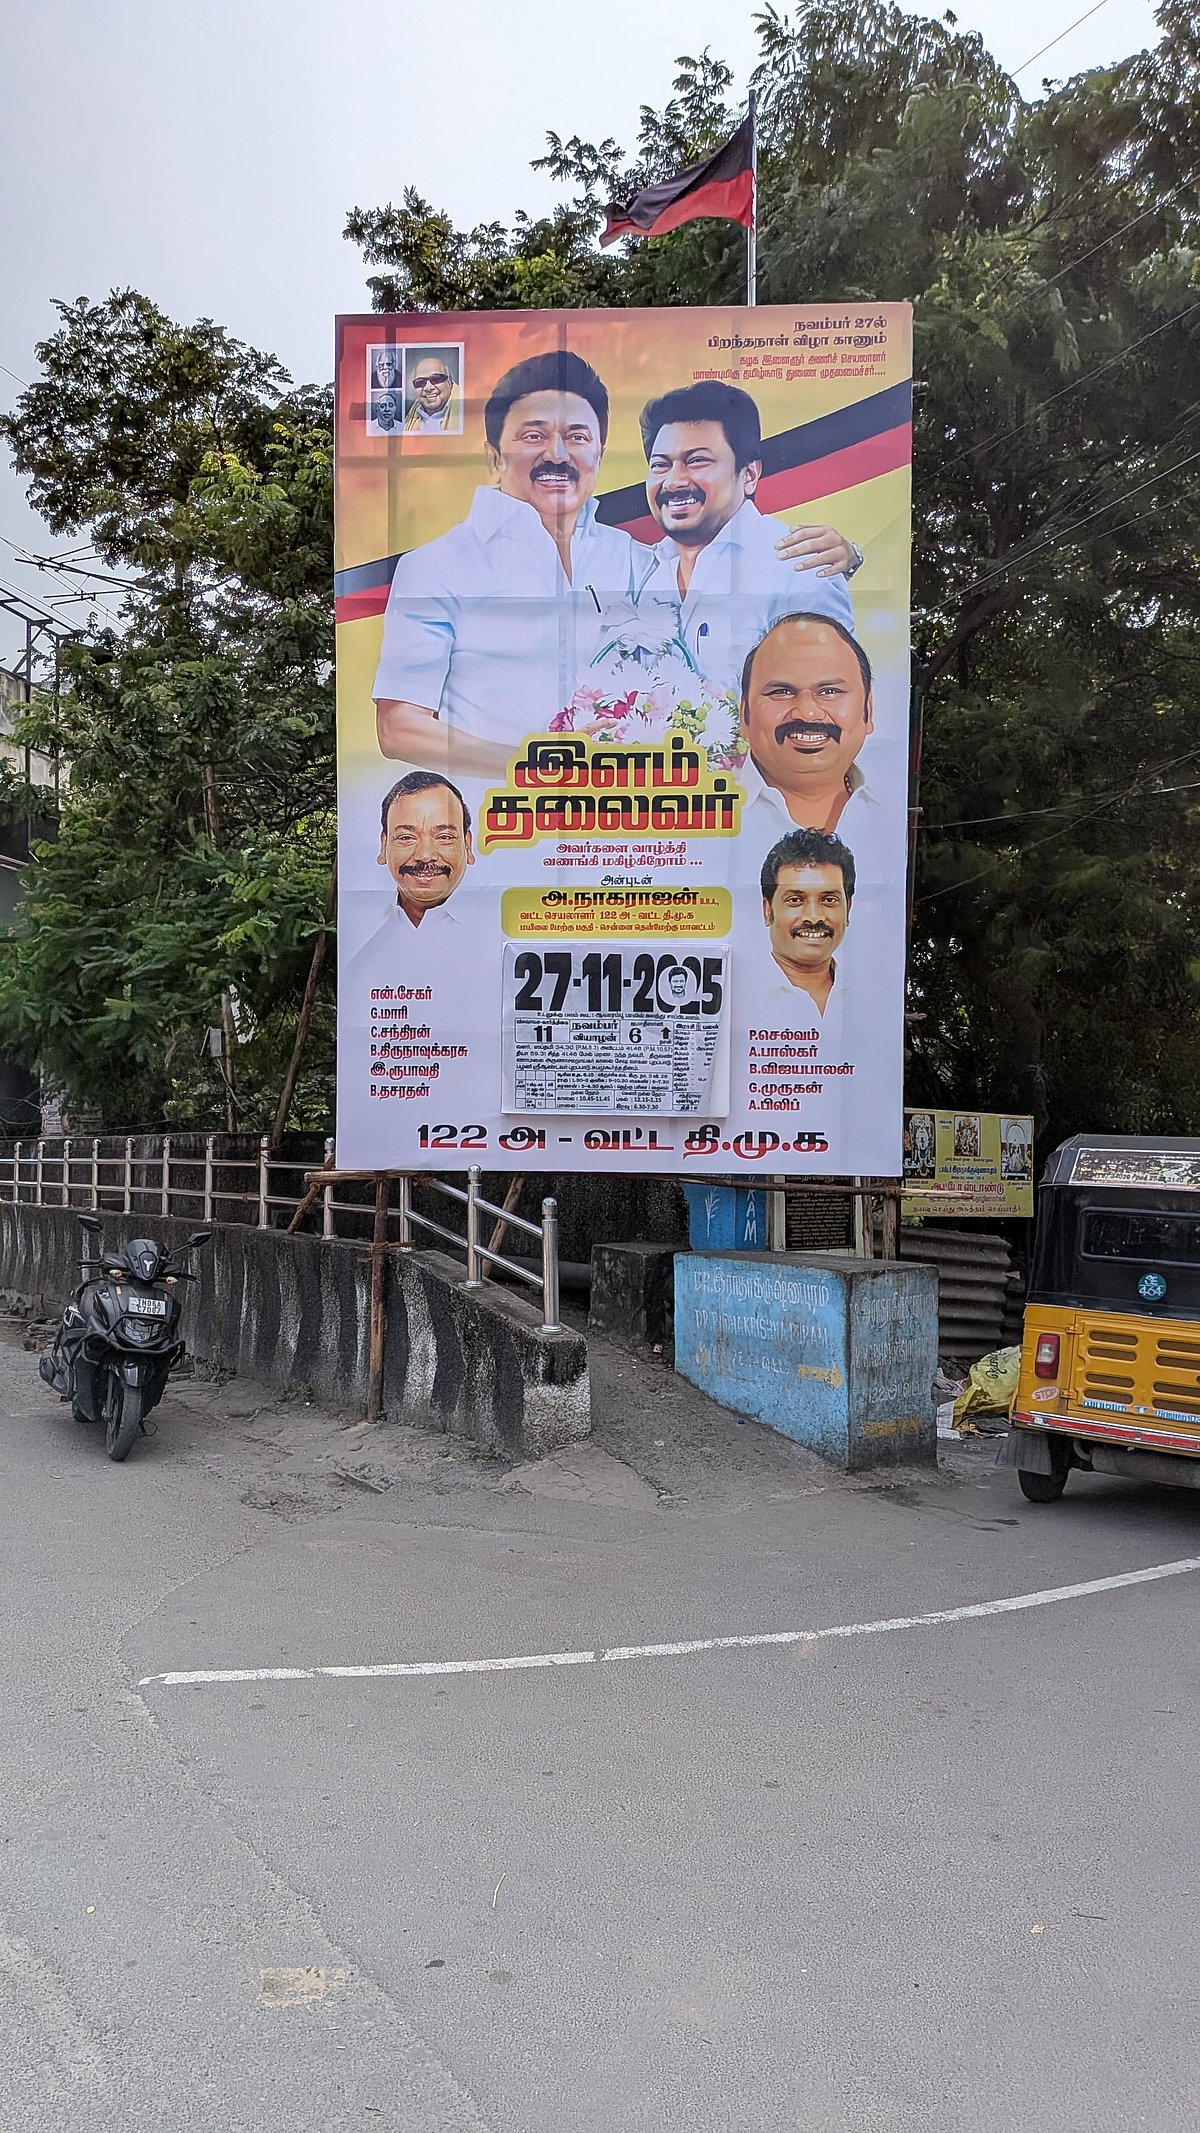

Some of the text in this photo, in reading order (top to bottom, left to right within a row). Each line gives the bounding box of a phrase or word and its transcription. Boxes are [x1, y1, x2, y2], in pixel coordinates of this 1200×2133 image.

[794, 315, 887, 333] நவம்பர் 27ல்
[708, 332, 887, 350] பிறந்தநாள் விழா காணும்
[740, 351, 886, 367] கழக இளைஞர் அணிச் செயலாளர்
[693, 368, 740, 381] மாண்புமிகு
[743, 367, 783, 380] தமிழ்நாடு
[786, 368, 817, 381] துணை
[514, 736, 699, 788] இளம்
[485, 778, 740, 847] தலைவர்
[556, 840, 687, 855] அவர்களை வாழ்த்தி
[543, 855, 599, 867] வணங்கி
[602, 854, 687, 868] மகிழ்கிறோம்
[600, 874, 654, 887] அன்புடன்
[541, 887, 700, 911] அ.நாகராஜன்
[520, 911, 542, 920] வட்ட
[545, 910, 595, 920] செயலாளர்
[599, 911, 618, 920] 122
[620, 911, 631, 920] அ
[638, 911, 660, 920] வட்ட
[662, 910, 694, 921] தி.மு.க
[520, 923, 549, 931] மயிலை
[550, 923, 575, 932] மேற்கு
[575, 923, 594, 932] பகுதி
[600, 923, 633, 931] சென்னை
[634, 922, 678, 932] தென்மேற்கு
[680, 922, 715, 931] மாவட்டம்
[370, 985, 432, 1000] என்.சேகர்
[370, 1005, 408, 1019] G.மாரி
[370, 1023, 431, 1041] C.சந்திரன்
[571, 1020, 619, 1030] நவம்பர்
[533, 1025, 553, 1042] 11
[573, 1033, 617, 1043] வியாழன்
[628, 1027, 642, 1044] 6
[749, 1028, 820, 1040] P.செல்வம்
[370, 1042, 468, 1060] B.திருநாவுக்கரசு
[749, 1044, 818, 1057] A.பாஸ்கர்
[370, 1061, 440, 1080] இ.ரூபாவதி
[749, 1062, 855, 1075] B.விஜயபாலன்
[370, 1082, 430, 1100] B.தசரதன்
[749, 1081, 823, 1097] G.முருகன்
[749, 1098, 800, 1110] A.பிலிப்
[417, 1124, 488, 1149] 122
[499, 1125, 545, 1151] அ
[584, 1127, 674, 1151] வட்ட
[683, 1124, 830, 1160] தி.மு.க
[1144, 1274, 1158, 1286] SE
[1138, 1286, 1163, 1296] 464
[1034, 1388, 1057, 1400] STOP
